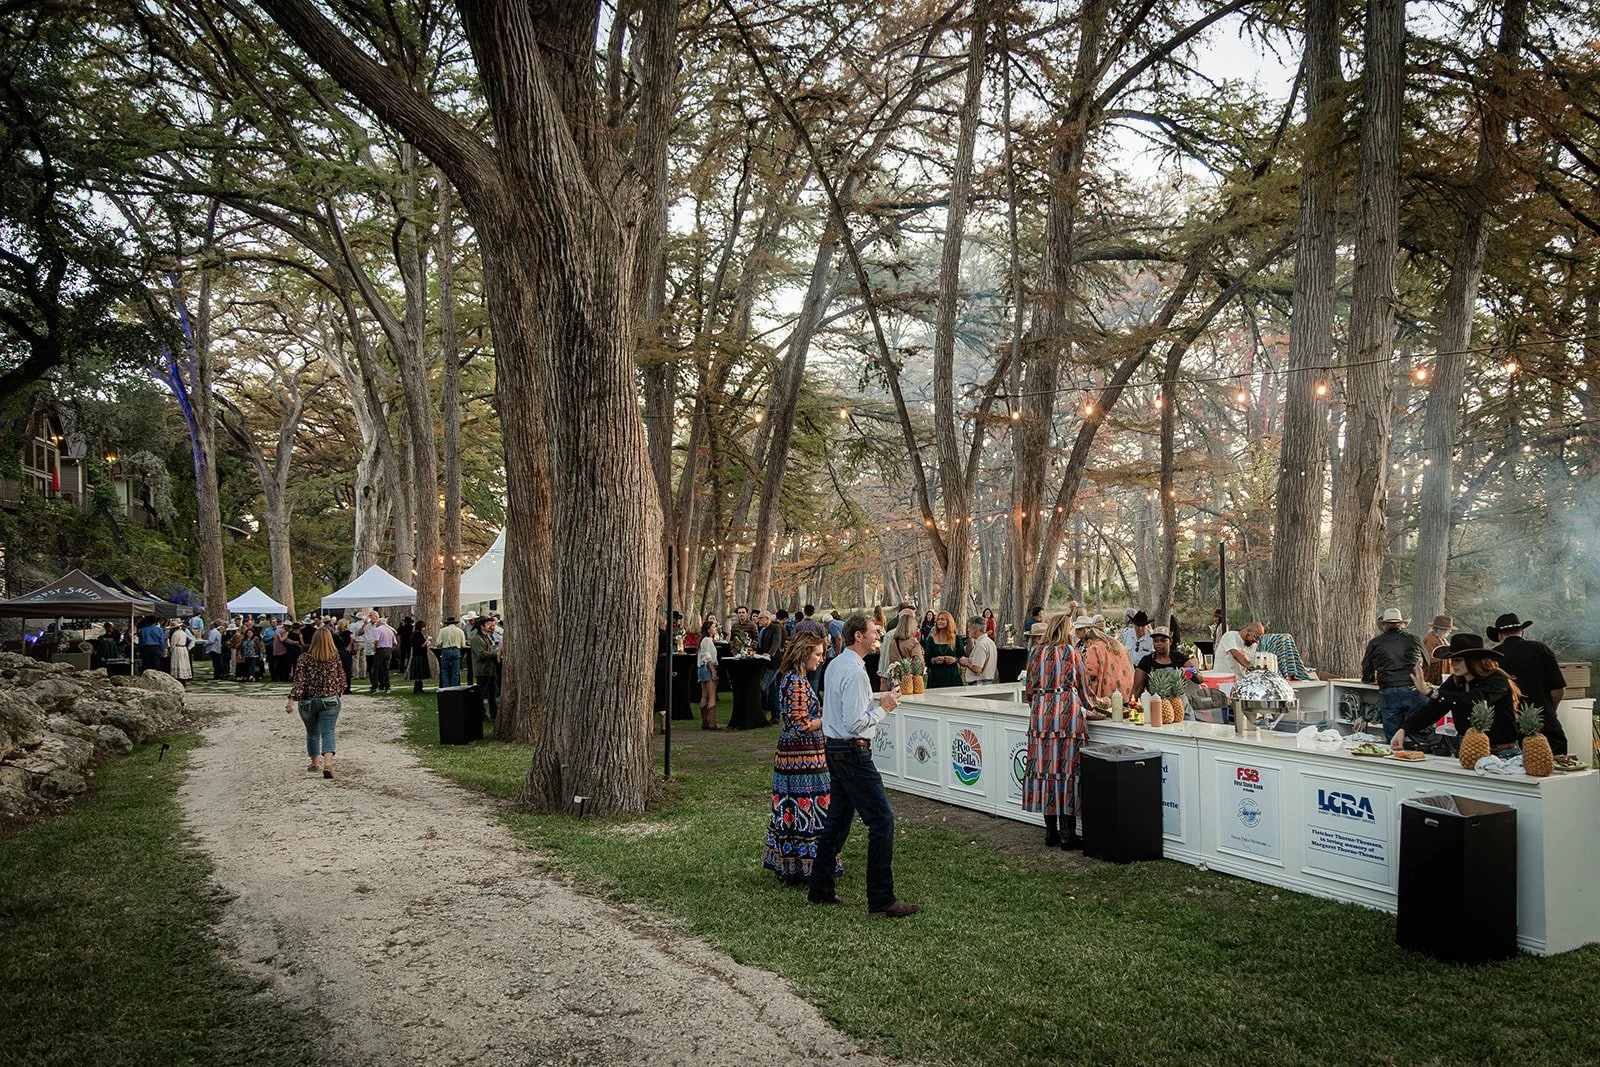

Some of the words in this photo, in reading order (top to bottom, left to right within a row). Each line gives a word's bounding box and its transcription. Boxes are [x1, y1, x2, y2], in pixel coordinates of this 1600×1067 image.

[957, 739, 970, 755] Rio
[957, 753, 976, 766] Bella
[1237, 767, 1260, 783] FSB
[1318, 789, 1375, 820] LCRA
[1312, 829, 1334, 838] Fletcher
[1311, 840, 1336, 850] Margaret
[1327, 838, 1343, 846] loving
[1345, 843, 1367, 852] memory
